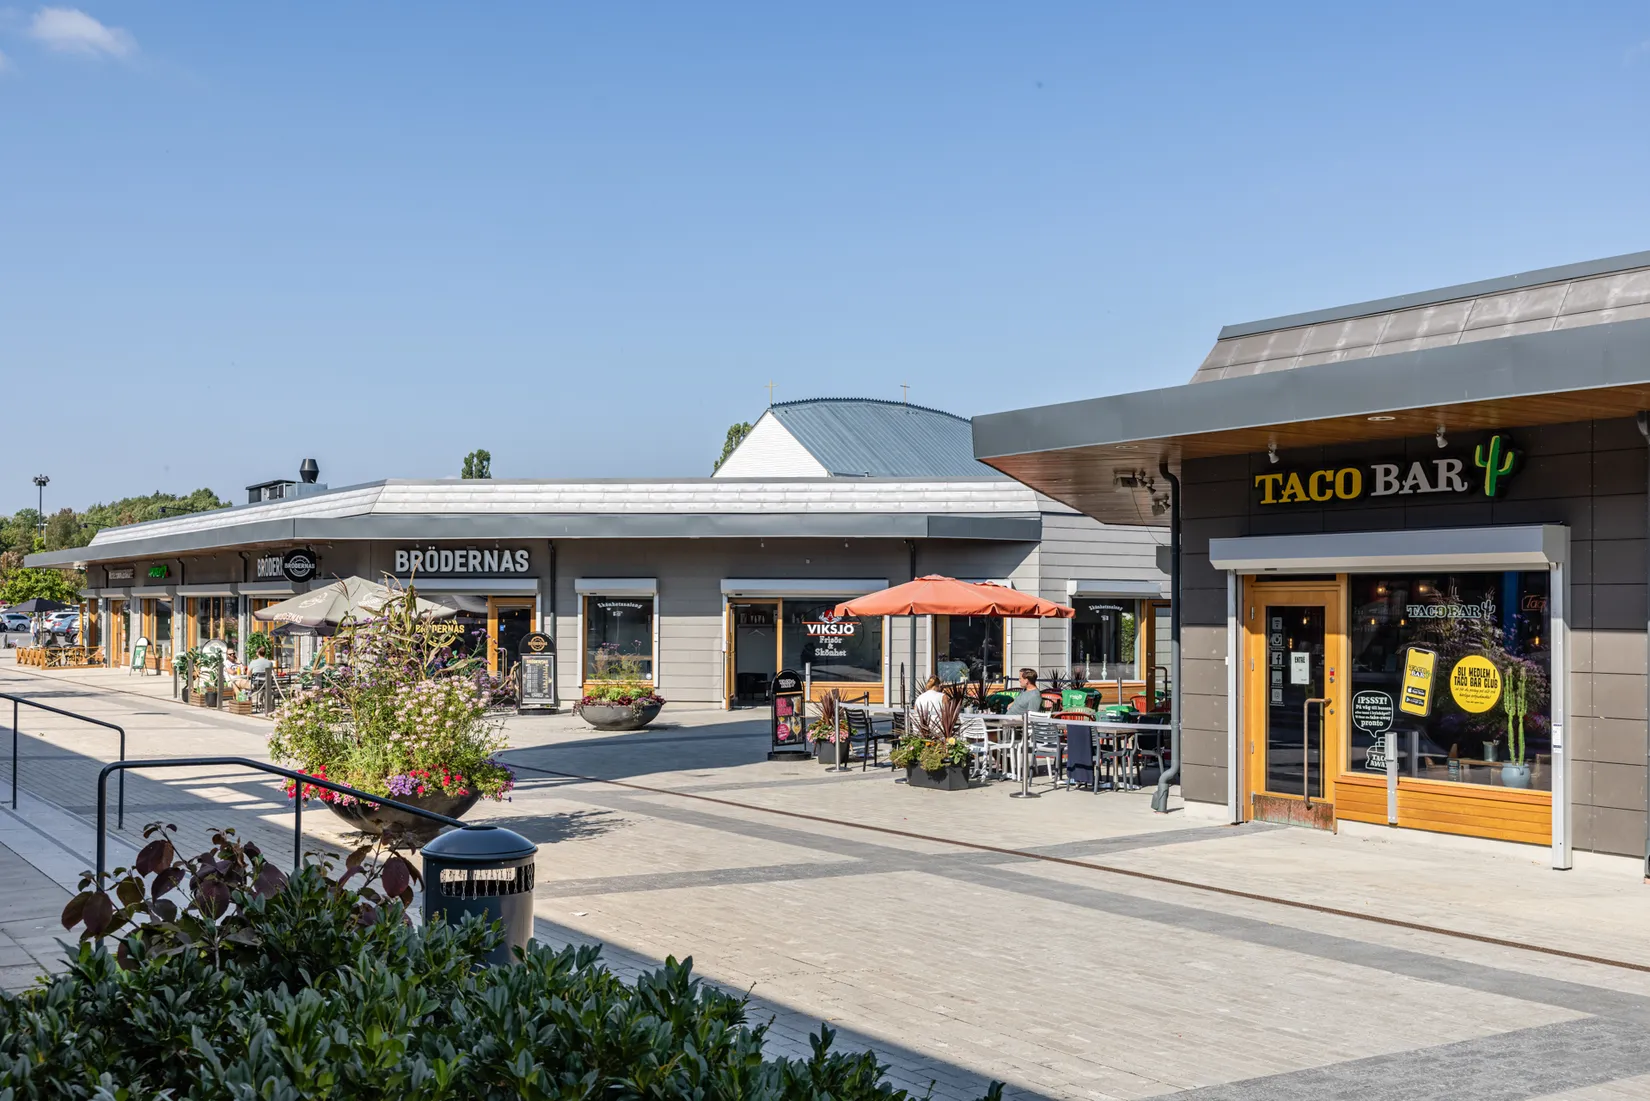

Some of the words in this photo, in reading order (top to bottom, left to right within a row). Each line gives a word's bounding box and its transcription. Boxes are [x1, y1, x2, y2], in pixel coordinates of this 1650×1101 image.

[1255, 467, 1362, 504] TACO
[1370, 458, 1468, 496] BAR
[257, 554, 285, 577] BRÖDERN
[395, 546, 529, 573] BRÖDERNAS
[1406, 604, 1447, 618] TACO
[1447, 604, 1481, 618] BAR
[415, 624, 465, 634] BRDERNAS
[807, 623, 855, 635] VIKSJÖ
[819, 636, 842, 644] Frisör
[814, 648, 847, 657] Skönhet
[1411, 670, 1425, 679] BAR
[1457, 666, 1467, 676] BLI
[1468, 667, 1491, 678] MEDLEM
[1454, 676, 1468, 687] TACO
[1470, 677, 1482, 687] BAR
[1484, 678, 1498, 689] CLUB
[1360, 720, 1384, 728] pronto
